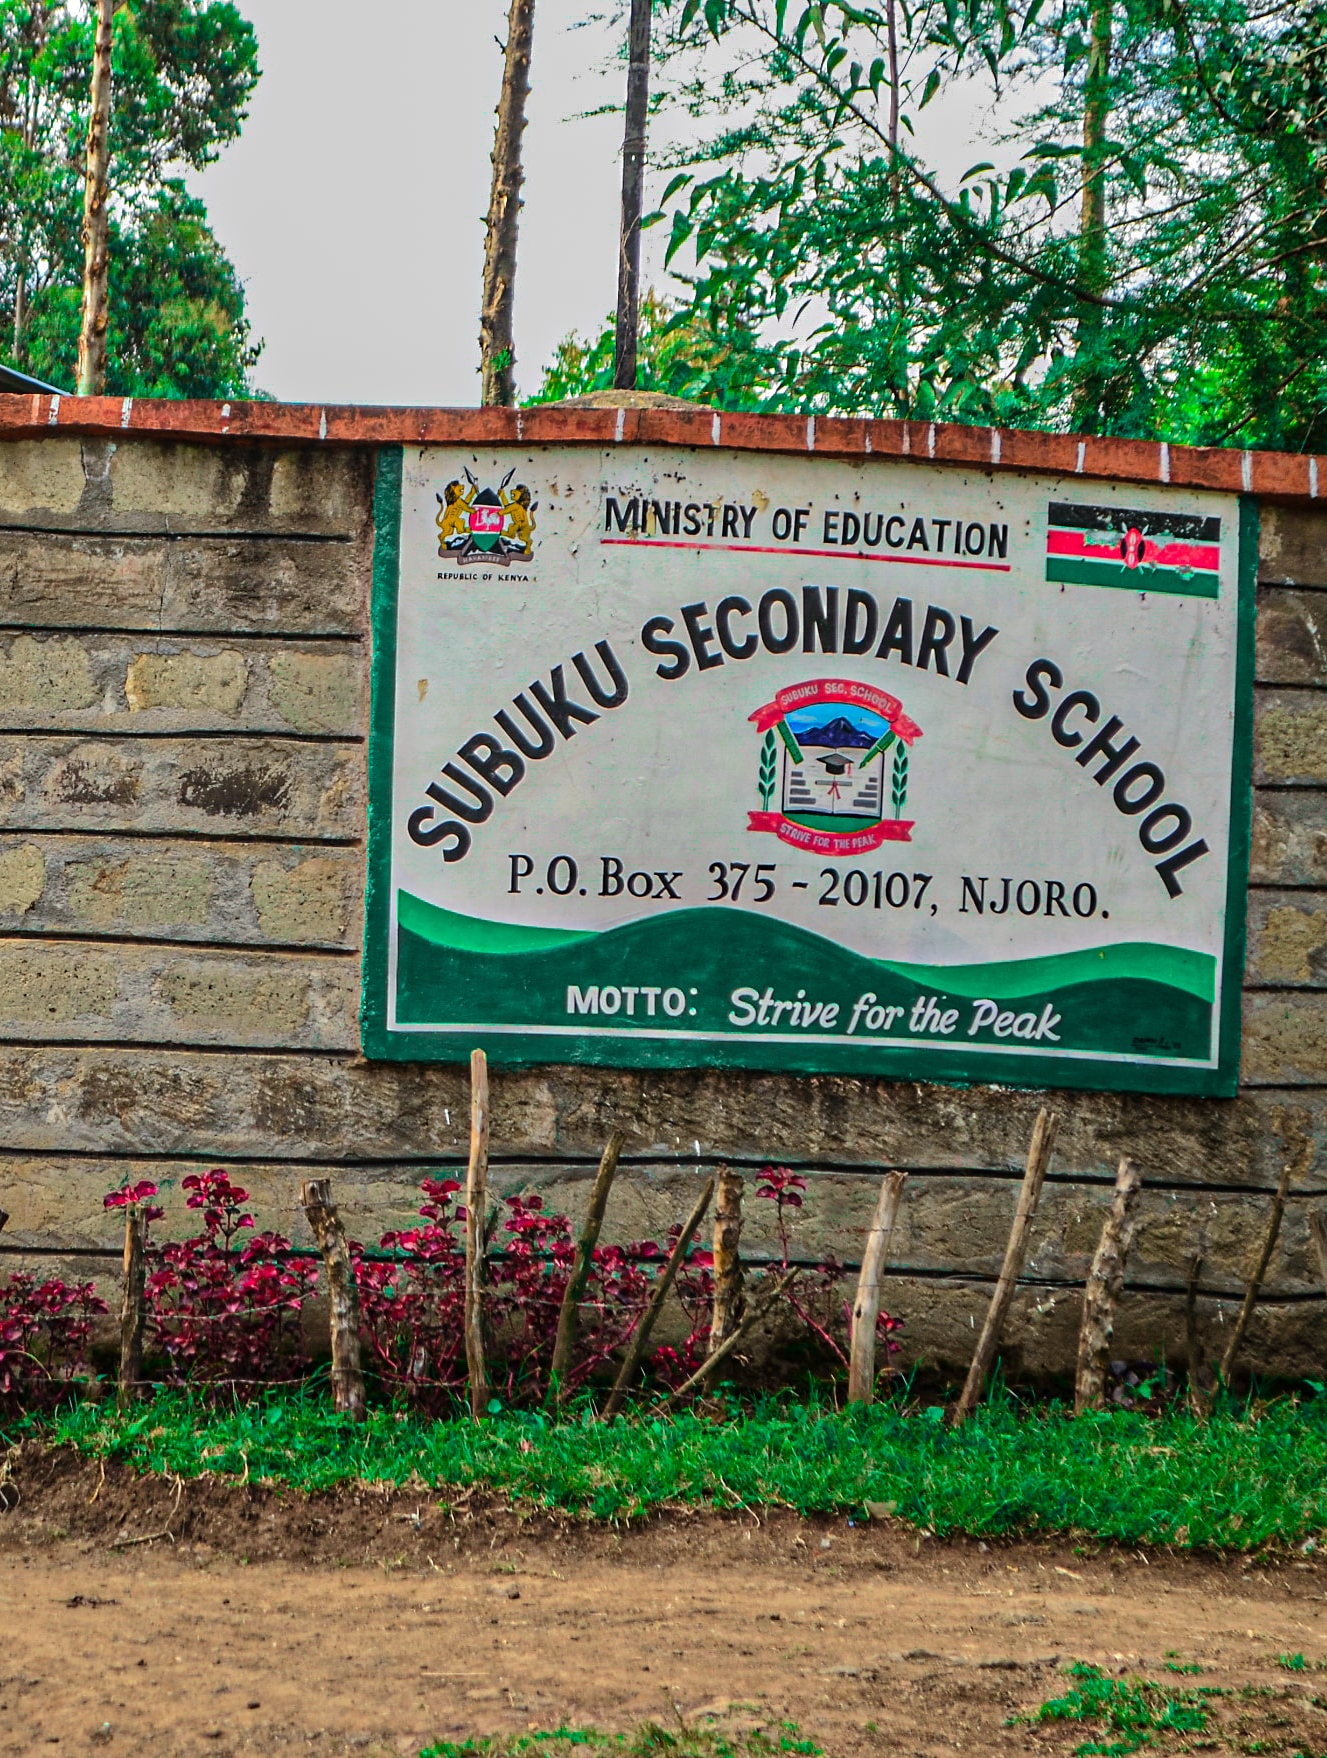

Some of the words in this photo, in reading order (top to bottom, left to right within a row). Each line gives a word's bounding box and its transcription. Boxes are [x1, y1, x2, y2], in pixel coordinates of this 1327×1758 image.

[605, 497, 757, 539] MINISTRY
[772, 508, 810, 542] OF
[822, 510, 1009, 559] EDUCATION
[437, 572, 478, 581] REPUBLIC
[482, 573, 493, 581] OF
[498, 574, 529, 582] KENYA
[781, 684, 819, 706] SUBUKU
[824, 683, 848, 695] SEC.
[850, 686, 893, 714] SCHOOL
[407, 639, 630, 863] SUBUKU
[641, 585, 1000, 685] SECONDARY
[1012, 657, 1211, 899] SCHOOL
[779, 823, 812, 844] STRIVE
[813, 834, 830, 849] FOR
[833, 838, 851, 849] THE
[852, 834, 876, 849] PEAK
[598, 856, 683, 900] Box
[959, 875, 1110, 920] NJORO.
[566, 984, 698, 1017] MOTTO:
[728, 987, 838, 1029] Strive
[846, 992, 905, 1035] for
[908, 995, 957, 1035] the
[967, 998, 1062, 1041] Peak
